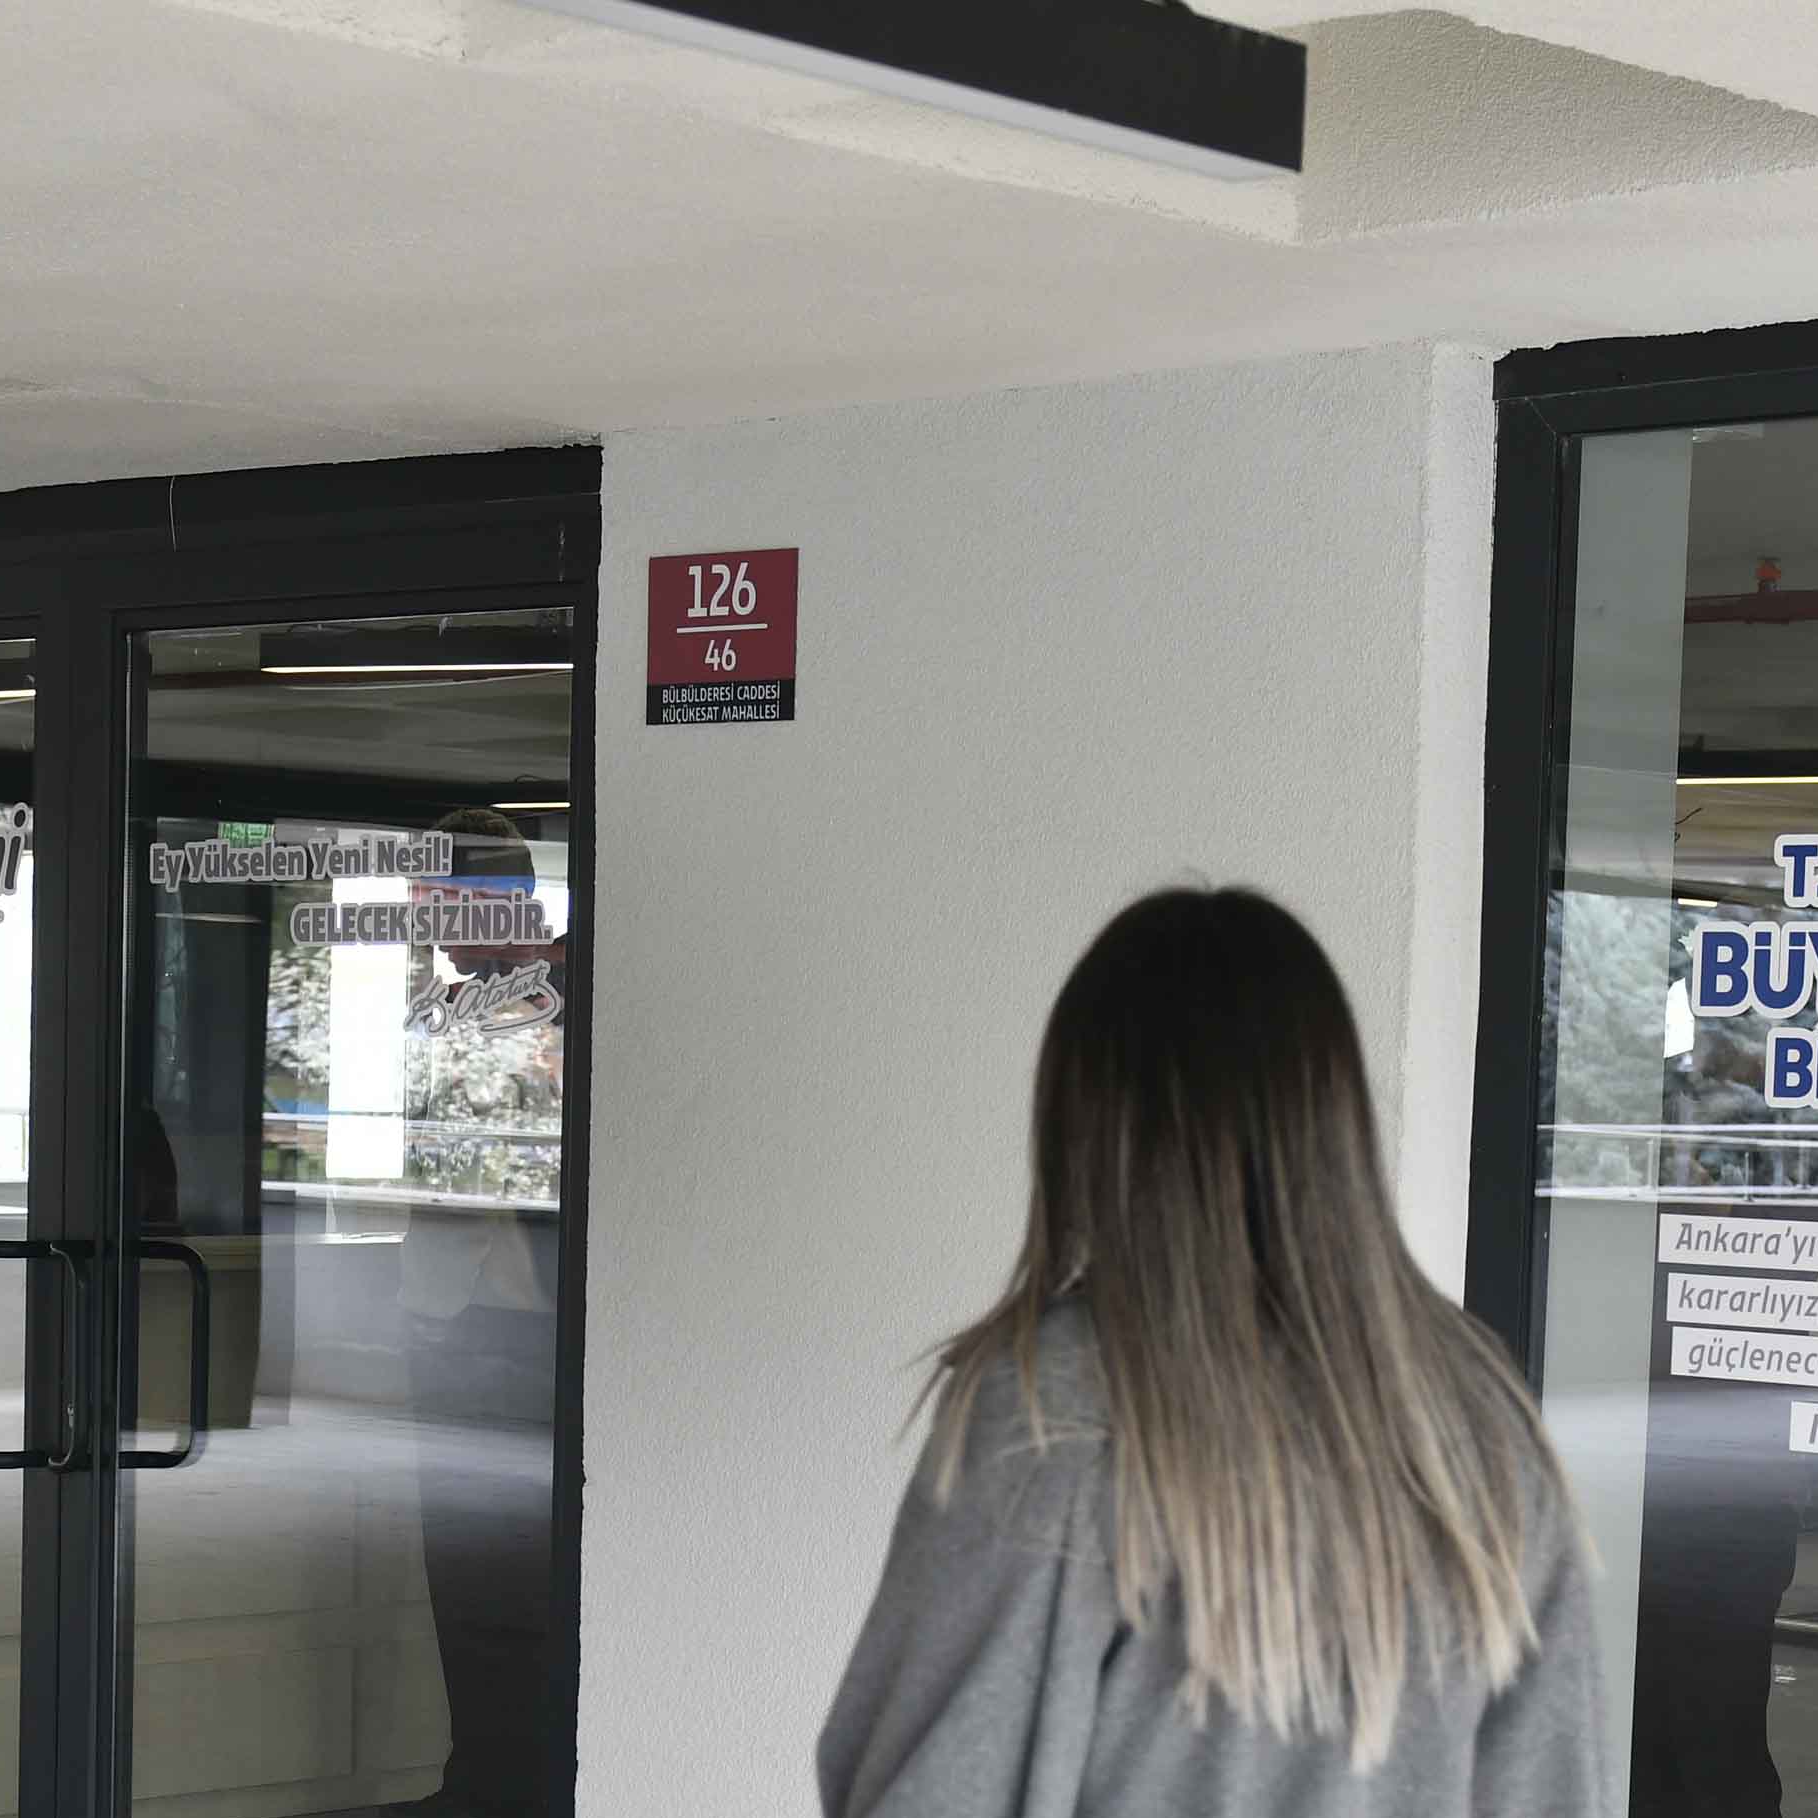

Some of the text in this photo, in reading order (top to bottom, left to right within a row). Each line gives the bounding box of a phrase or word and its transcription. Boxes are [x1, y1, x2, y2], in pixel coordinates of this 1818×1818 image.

[687, 562, 757, 618] 126
[704, 638, 737, 672] 46
[662, 680, 781, 704] BÜLBÜLDERESİ CADDESİ
[662, 701, 780, 724] KÜÇÜKESAT MAHALLESİ
[153, 835, 450, 888] Ey Yükselen Yeni Nesil!
[293, 891, 552, 943] GELECEK SİZİNDİR.
[1675, 1222, 1817, 1265] Ankara'yı
